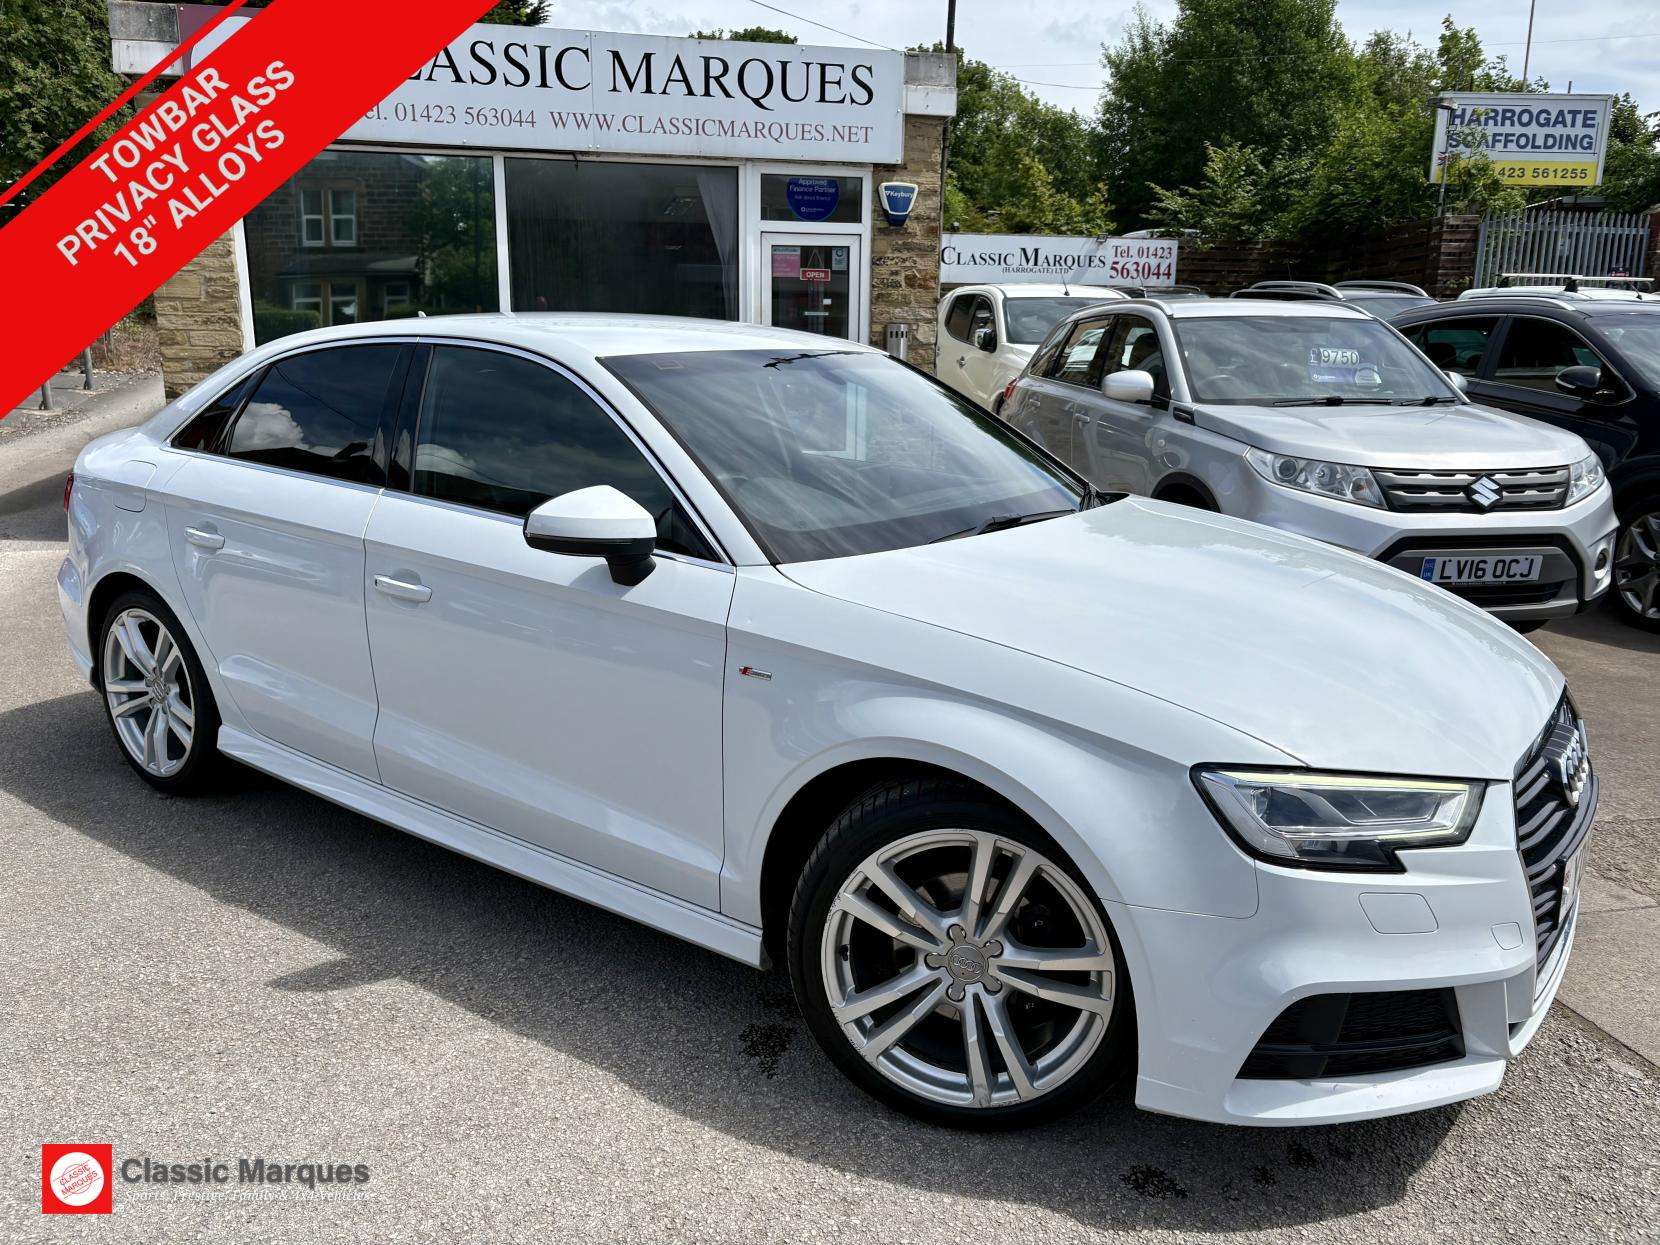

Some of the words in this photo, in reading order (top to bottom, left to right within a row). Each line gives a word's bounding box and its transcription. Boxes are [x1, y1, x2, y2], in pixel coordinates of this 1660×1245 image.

[408, 40, 592, 91] ASSIC
[606, 49, 874, 111] MARQUES
[394, 102, 457, 125] 01423
[464, 105, 537, 128] 563044
[549, 111, 874, 144] WWW.CLASSICMARQUES.NET
[1451, 107, 1598, 129] HARROGATE
[1498, 167, 1526, 179] 423
[1531, 167, 1588, 179] 561255
[1112, 245, 1134, 259] Tel.
[1138, 246, 1173, 260] 01423
[806, 270, 825, 279] OPEN
[1109, 261, 1173, 280] 563044
[1439, 559, 1488, 580] LV16
[1493, 558, 1535, 579] OCJ
